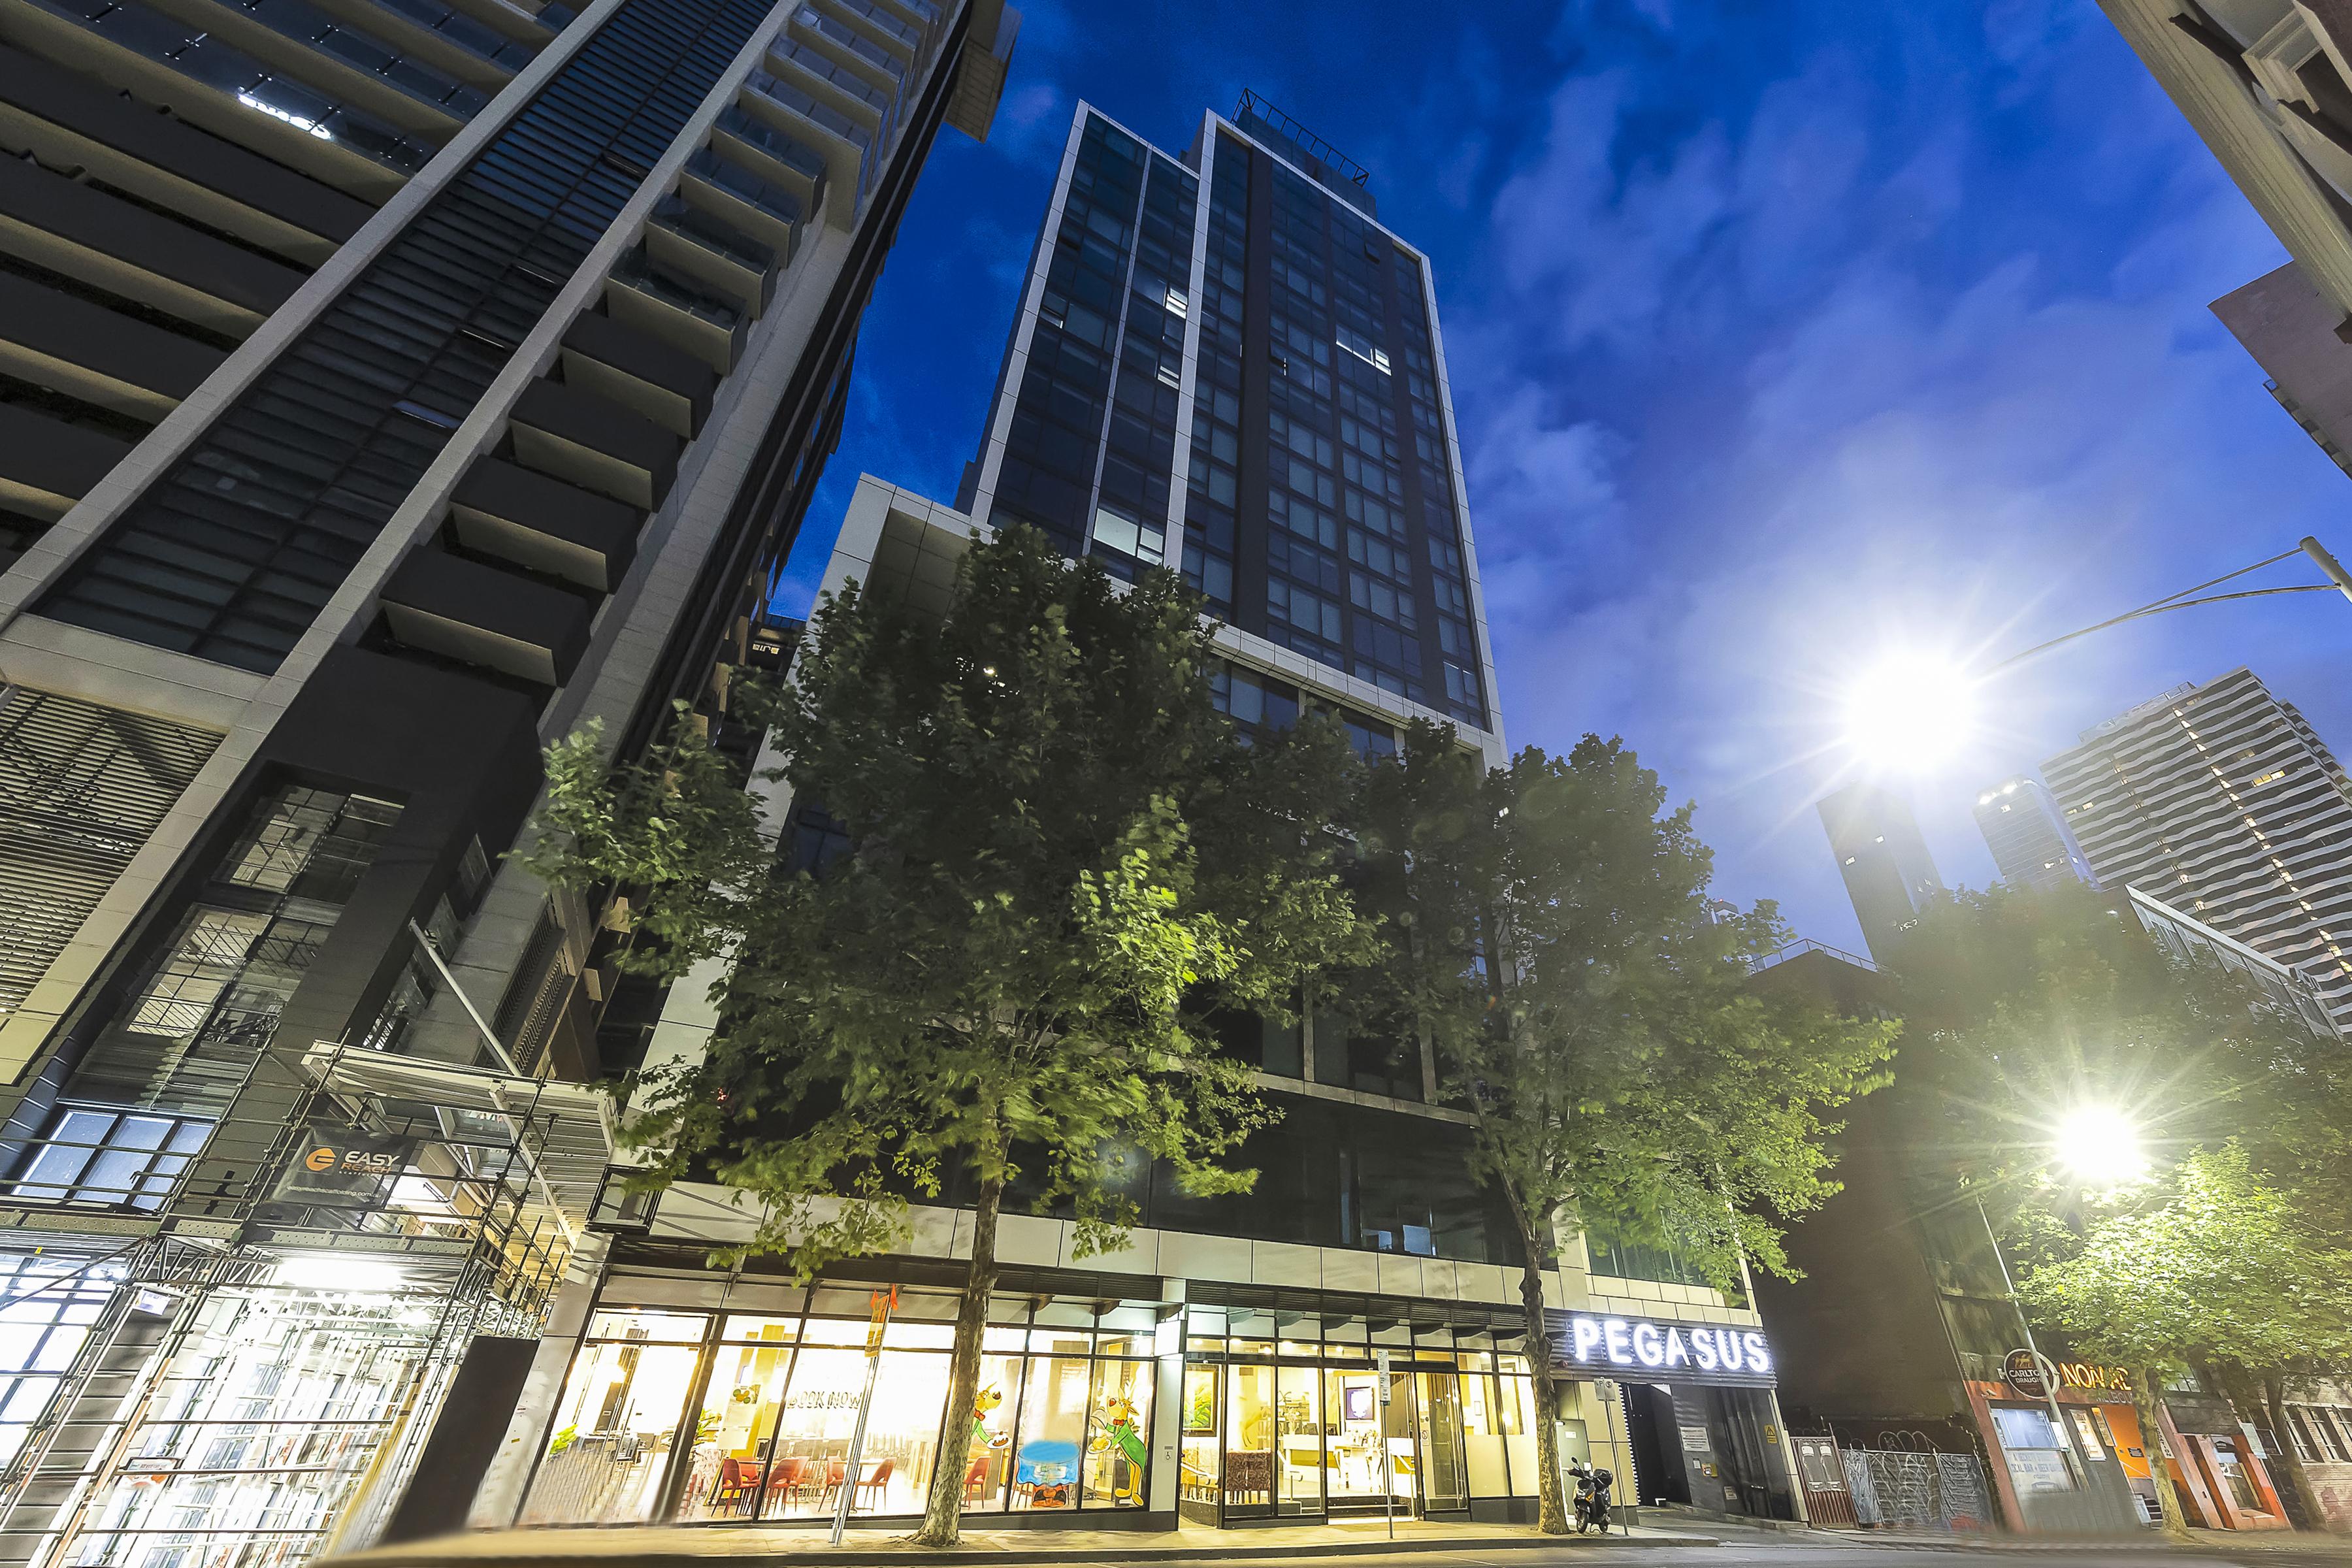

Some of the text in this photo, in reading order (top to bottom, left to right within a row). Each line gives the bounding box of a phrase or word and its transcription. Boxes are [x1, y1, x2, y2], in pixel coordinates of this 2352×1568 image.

[344, 1151, 400, 1166] EASY
[340, 1162, 391, 1173] REACH
[1573, 1318, 1769, 1373] PEGASUS
[787, 1391, 862, 1409] BOOK NOW
